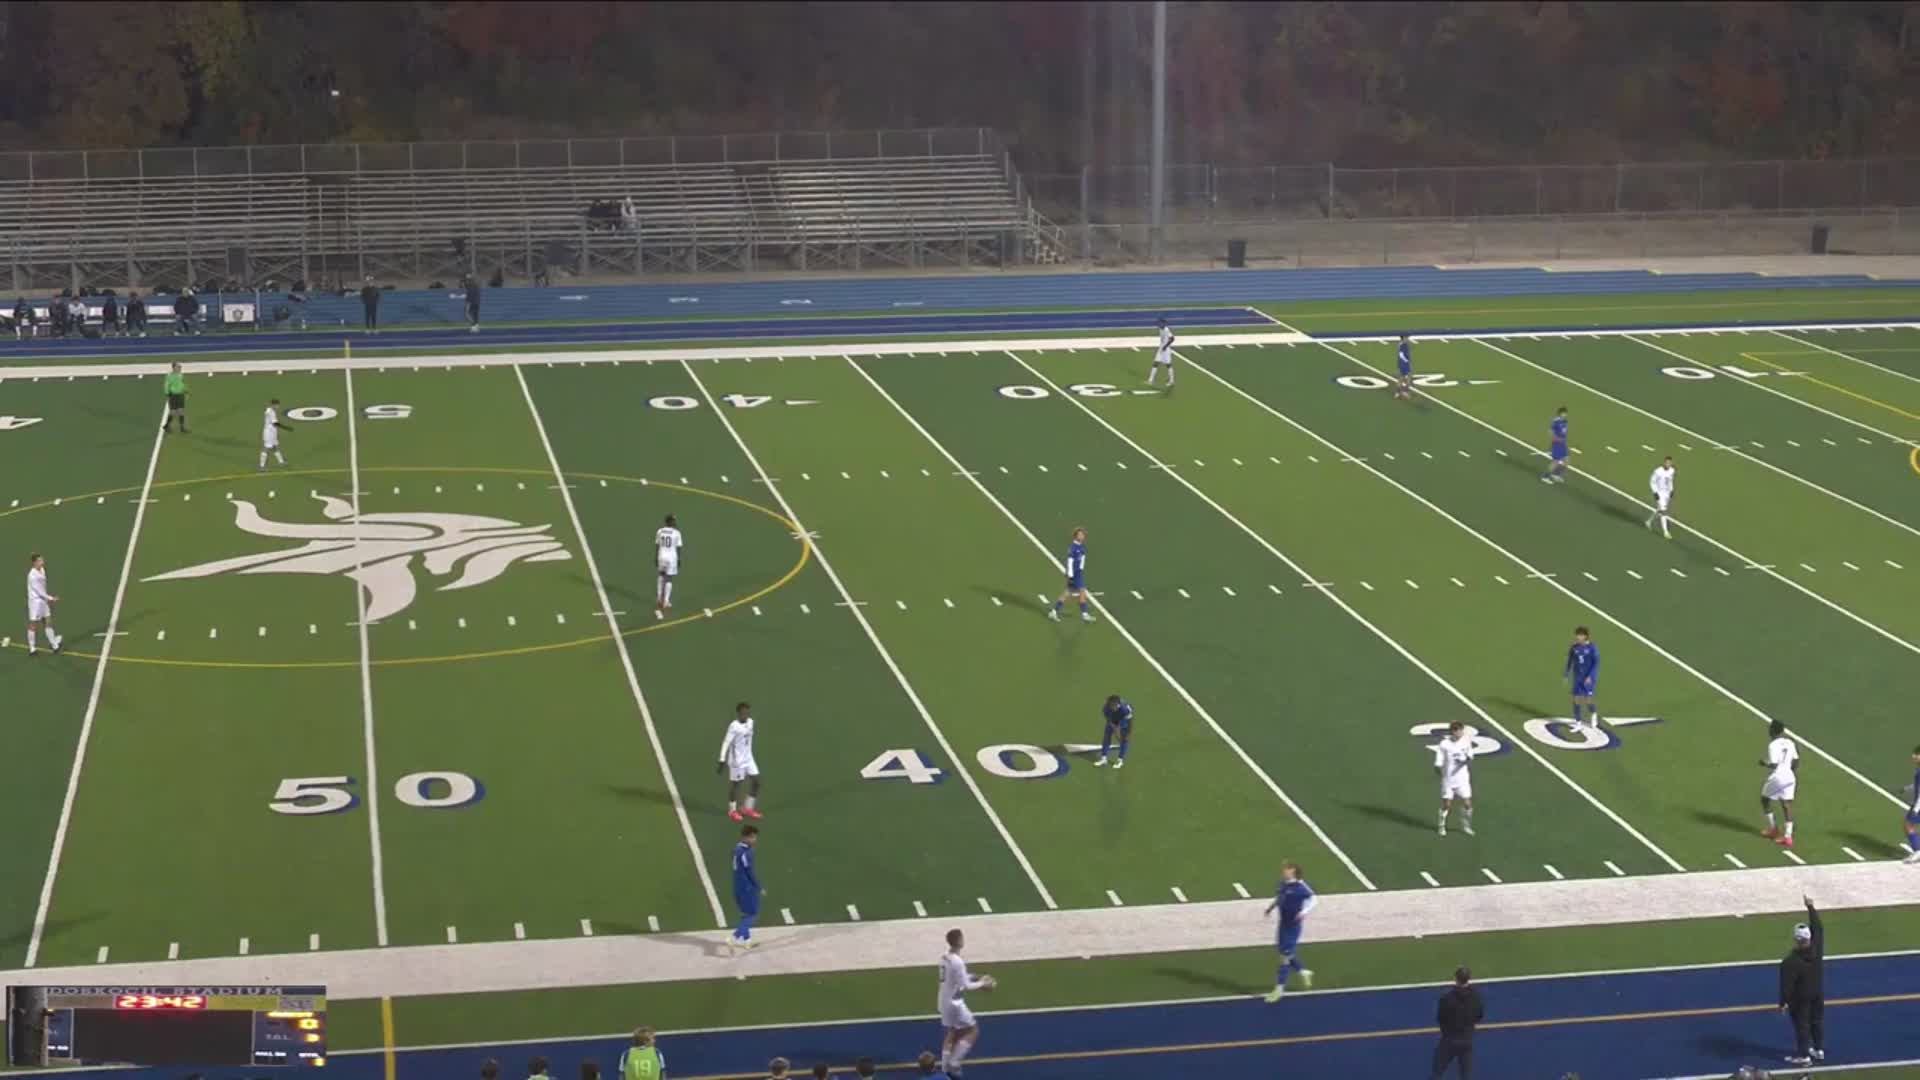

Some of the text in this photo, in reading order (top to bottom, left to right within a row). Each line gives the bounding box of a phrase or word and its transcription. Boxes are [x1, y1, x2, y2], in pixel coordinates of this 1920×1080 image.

[660, 535, 672, 548] 10
[173, 986, 283, 996] STADIUM
[118, 996, 202, 1008] 23:42
[634, 1059, 652, 1079] 19
